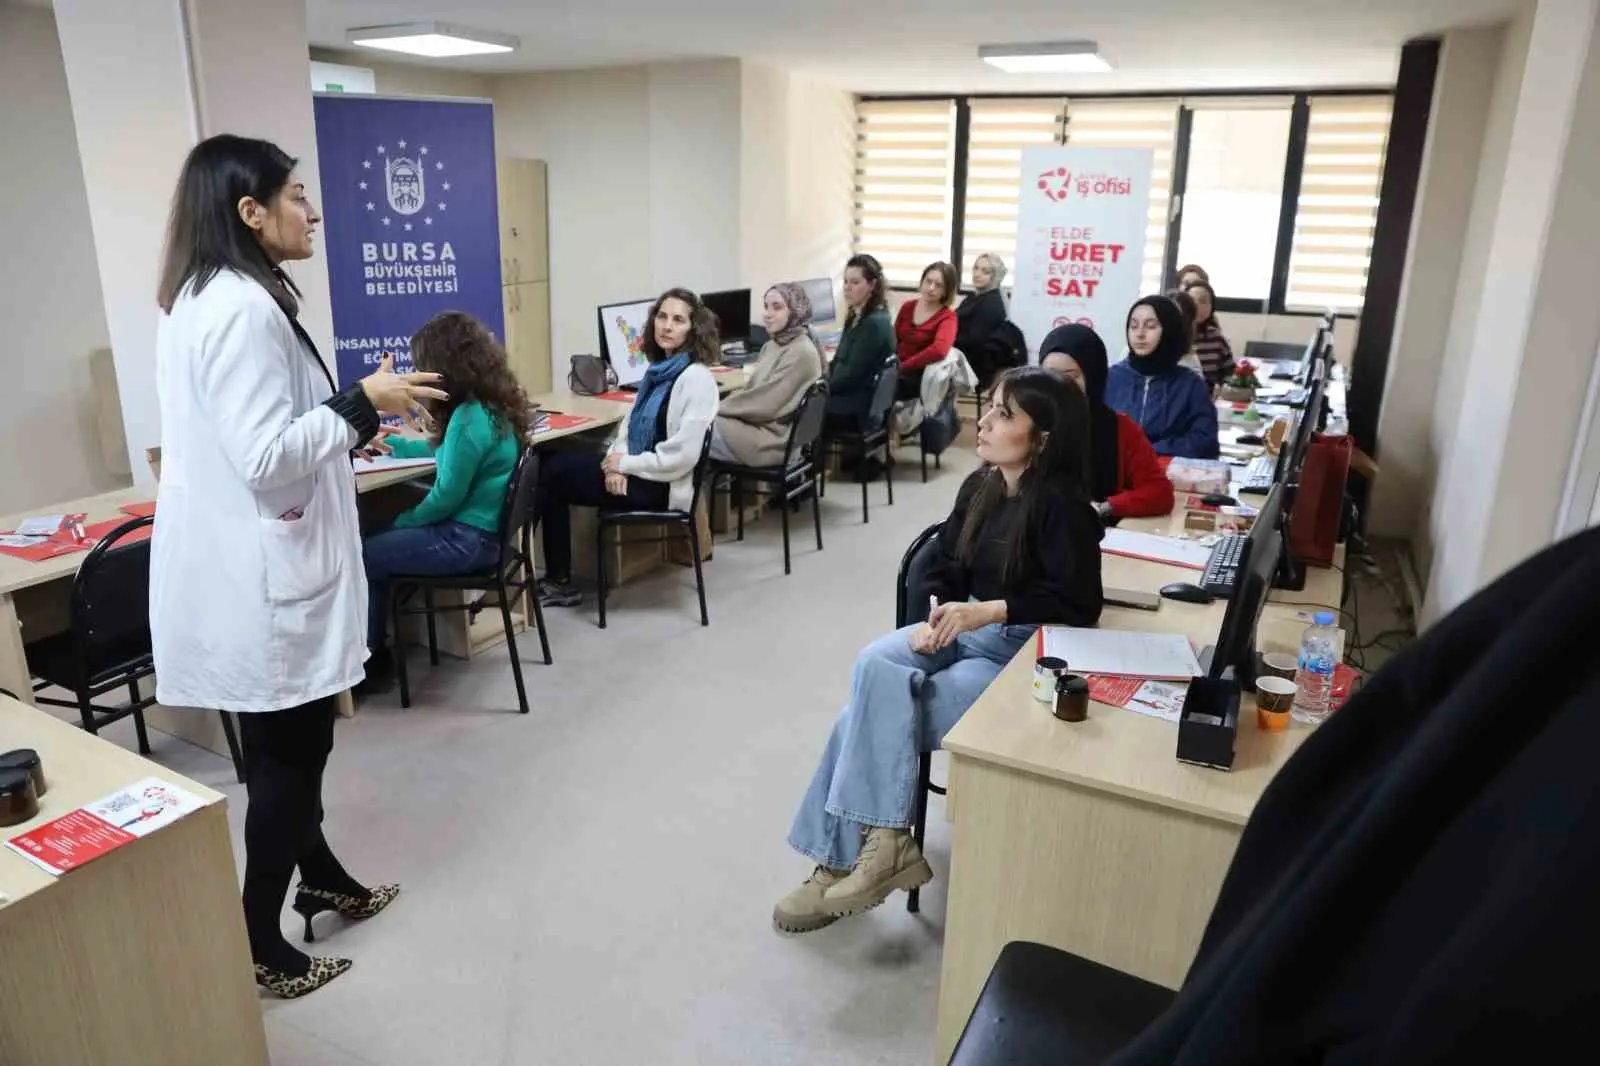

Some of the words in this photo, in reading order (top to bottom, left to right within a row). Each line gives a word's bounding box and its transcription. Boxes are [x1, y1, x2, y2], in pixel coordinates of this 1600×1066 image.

[1094, 176, 1131, 195] ofisi
[1051, 227, 1092, 240] ELDE
[362, 242, 456, 261] BURSA
[1050, 242, 1125, 263] ÜRET
[364, 261, 457, 278] BÜYÜKŞEHİR
[1047, 263, 1103, 277] EVDEN
[366, 277, 458, 295] BELEDİYESİ
[1046, 278, 1099, 298] SAT
[334, 336, 380, 350] İNSAN
